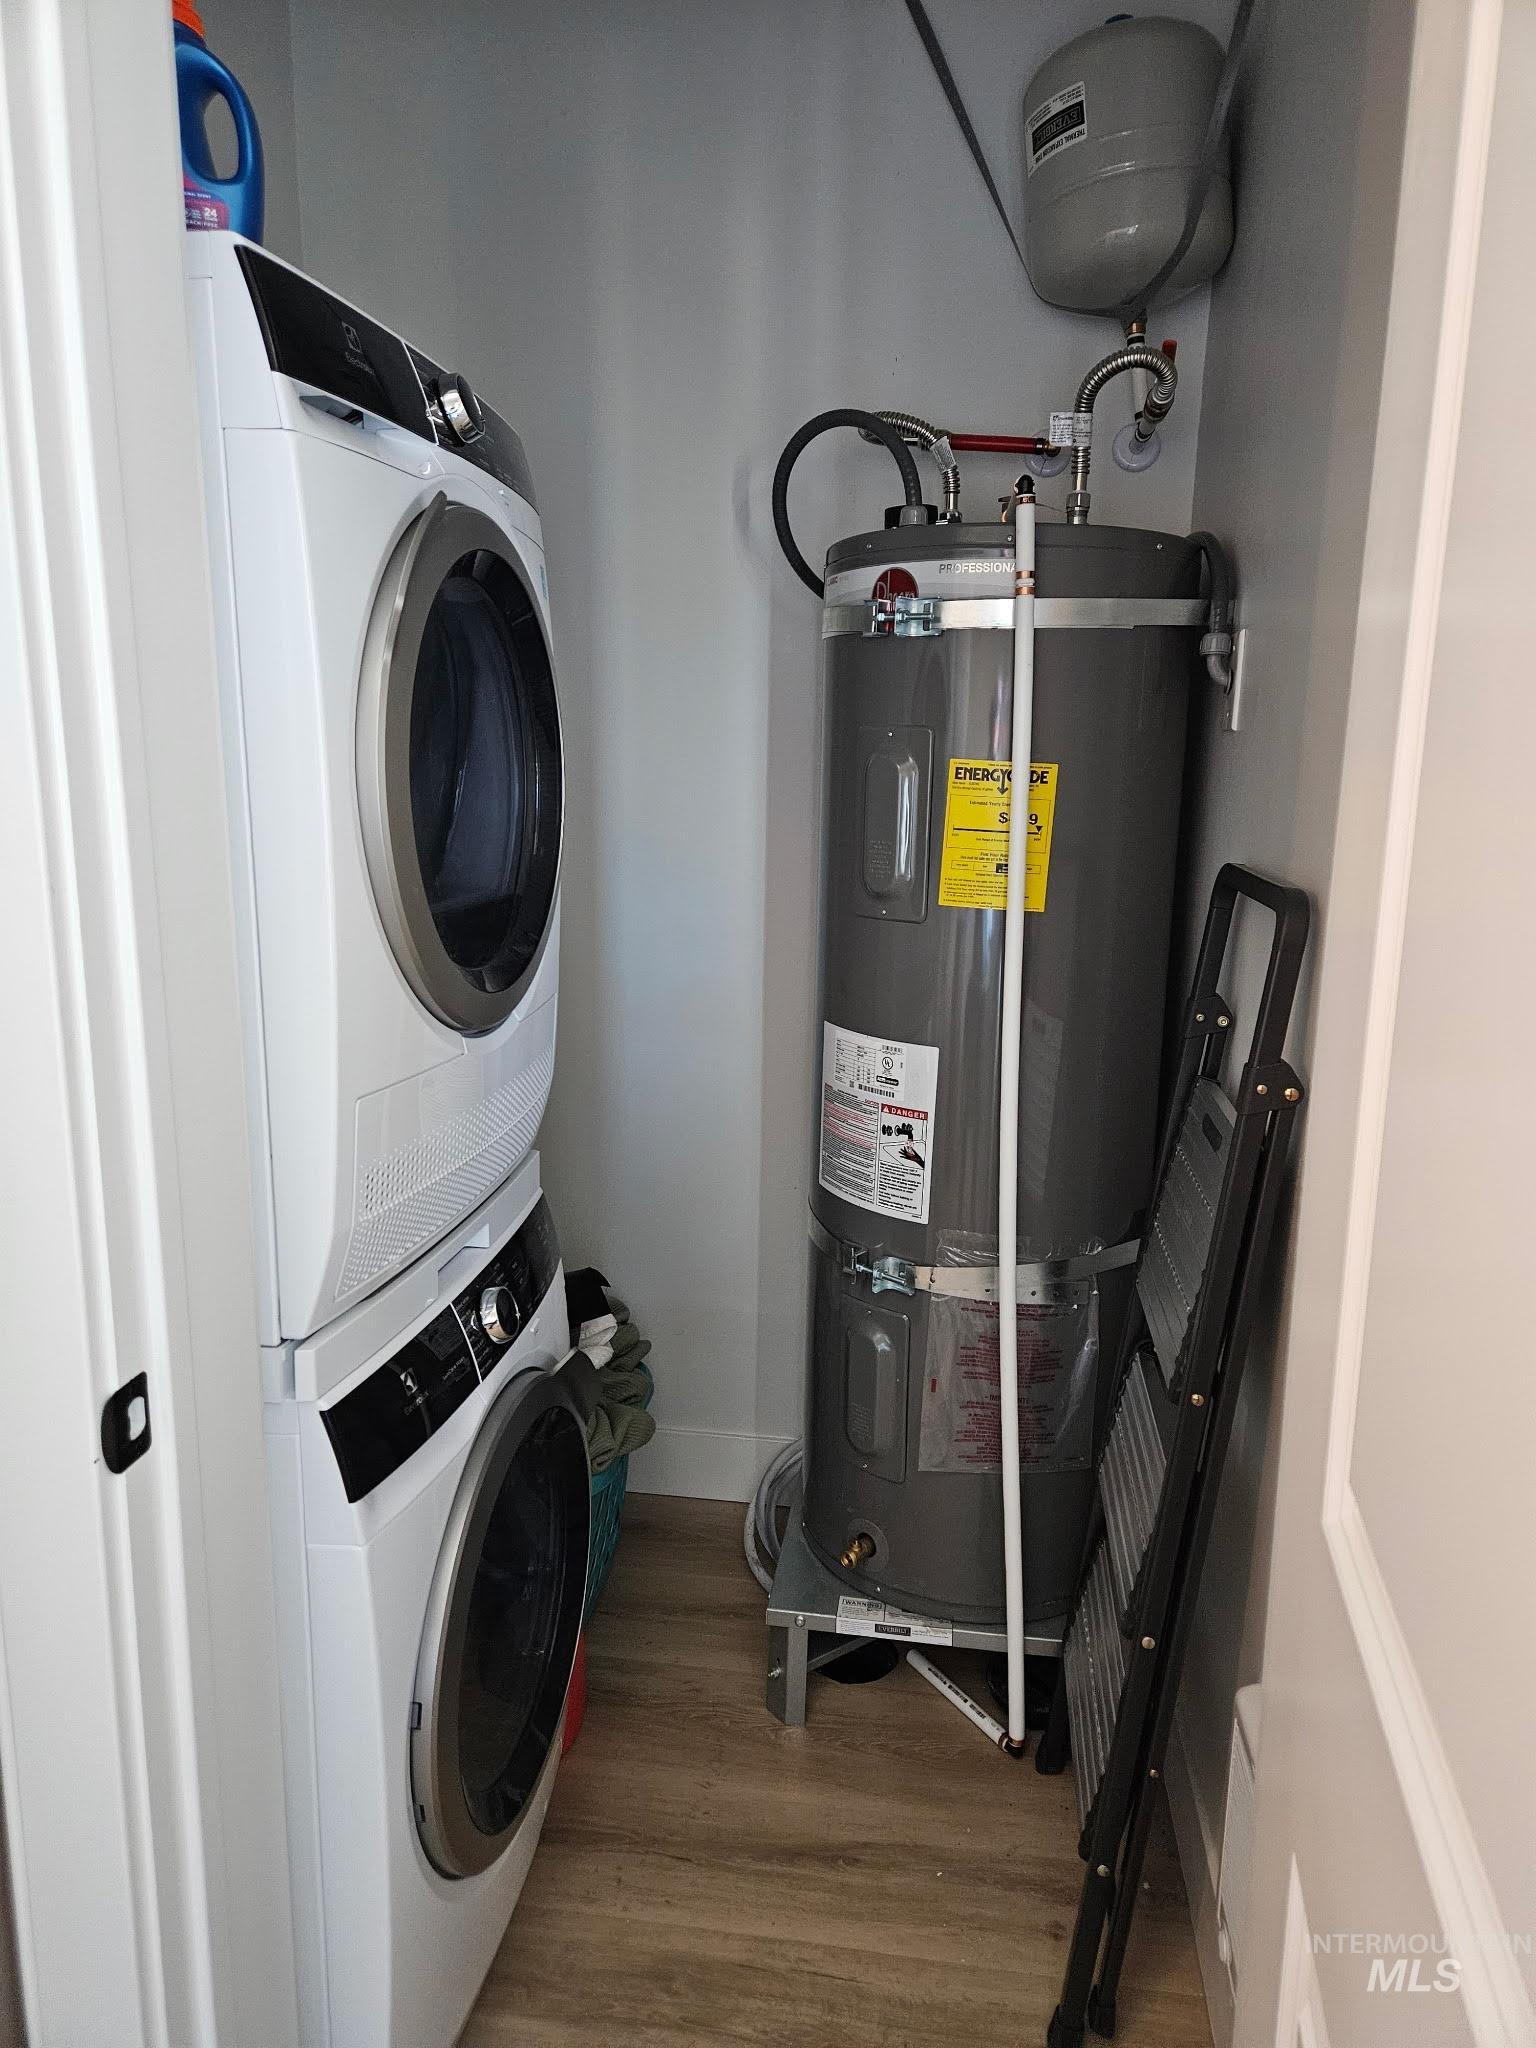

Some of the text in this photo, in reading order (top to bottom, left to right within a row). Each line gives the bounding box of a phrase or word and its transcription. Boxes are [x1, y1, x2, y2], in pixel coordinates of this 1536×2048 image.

[204, 207, 218, 218] 24
[939, 561, 1015, 575] PROFESSIONA
[954, 766, 1049, 785] ENERGYDE
[891, 1107, 926, 1120] DANGER
